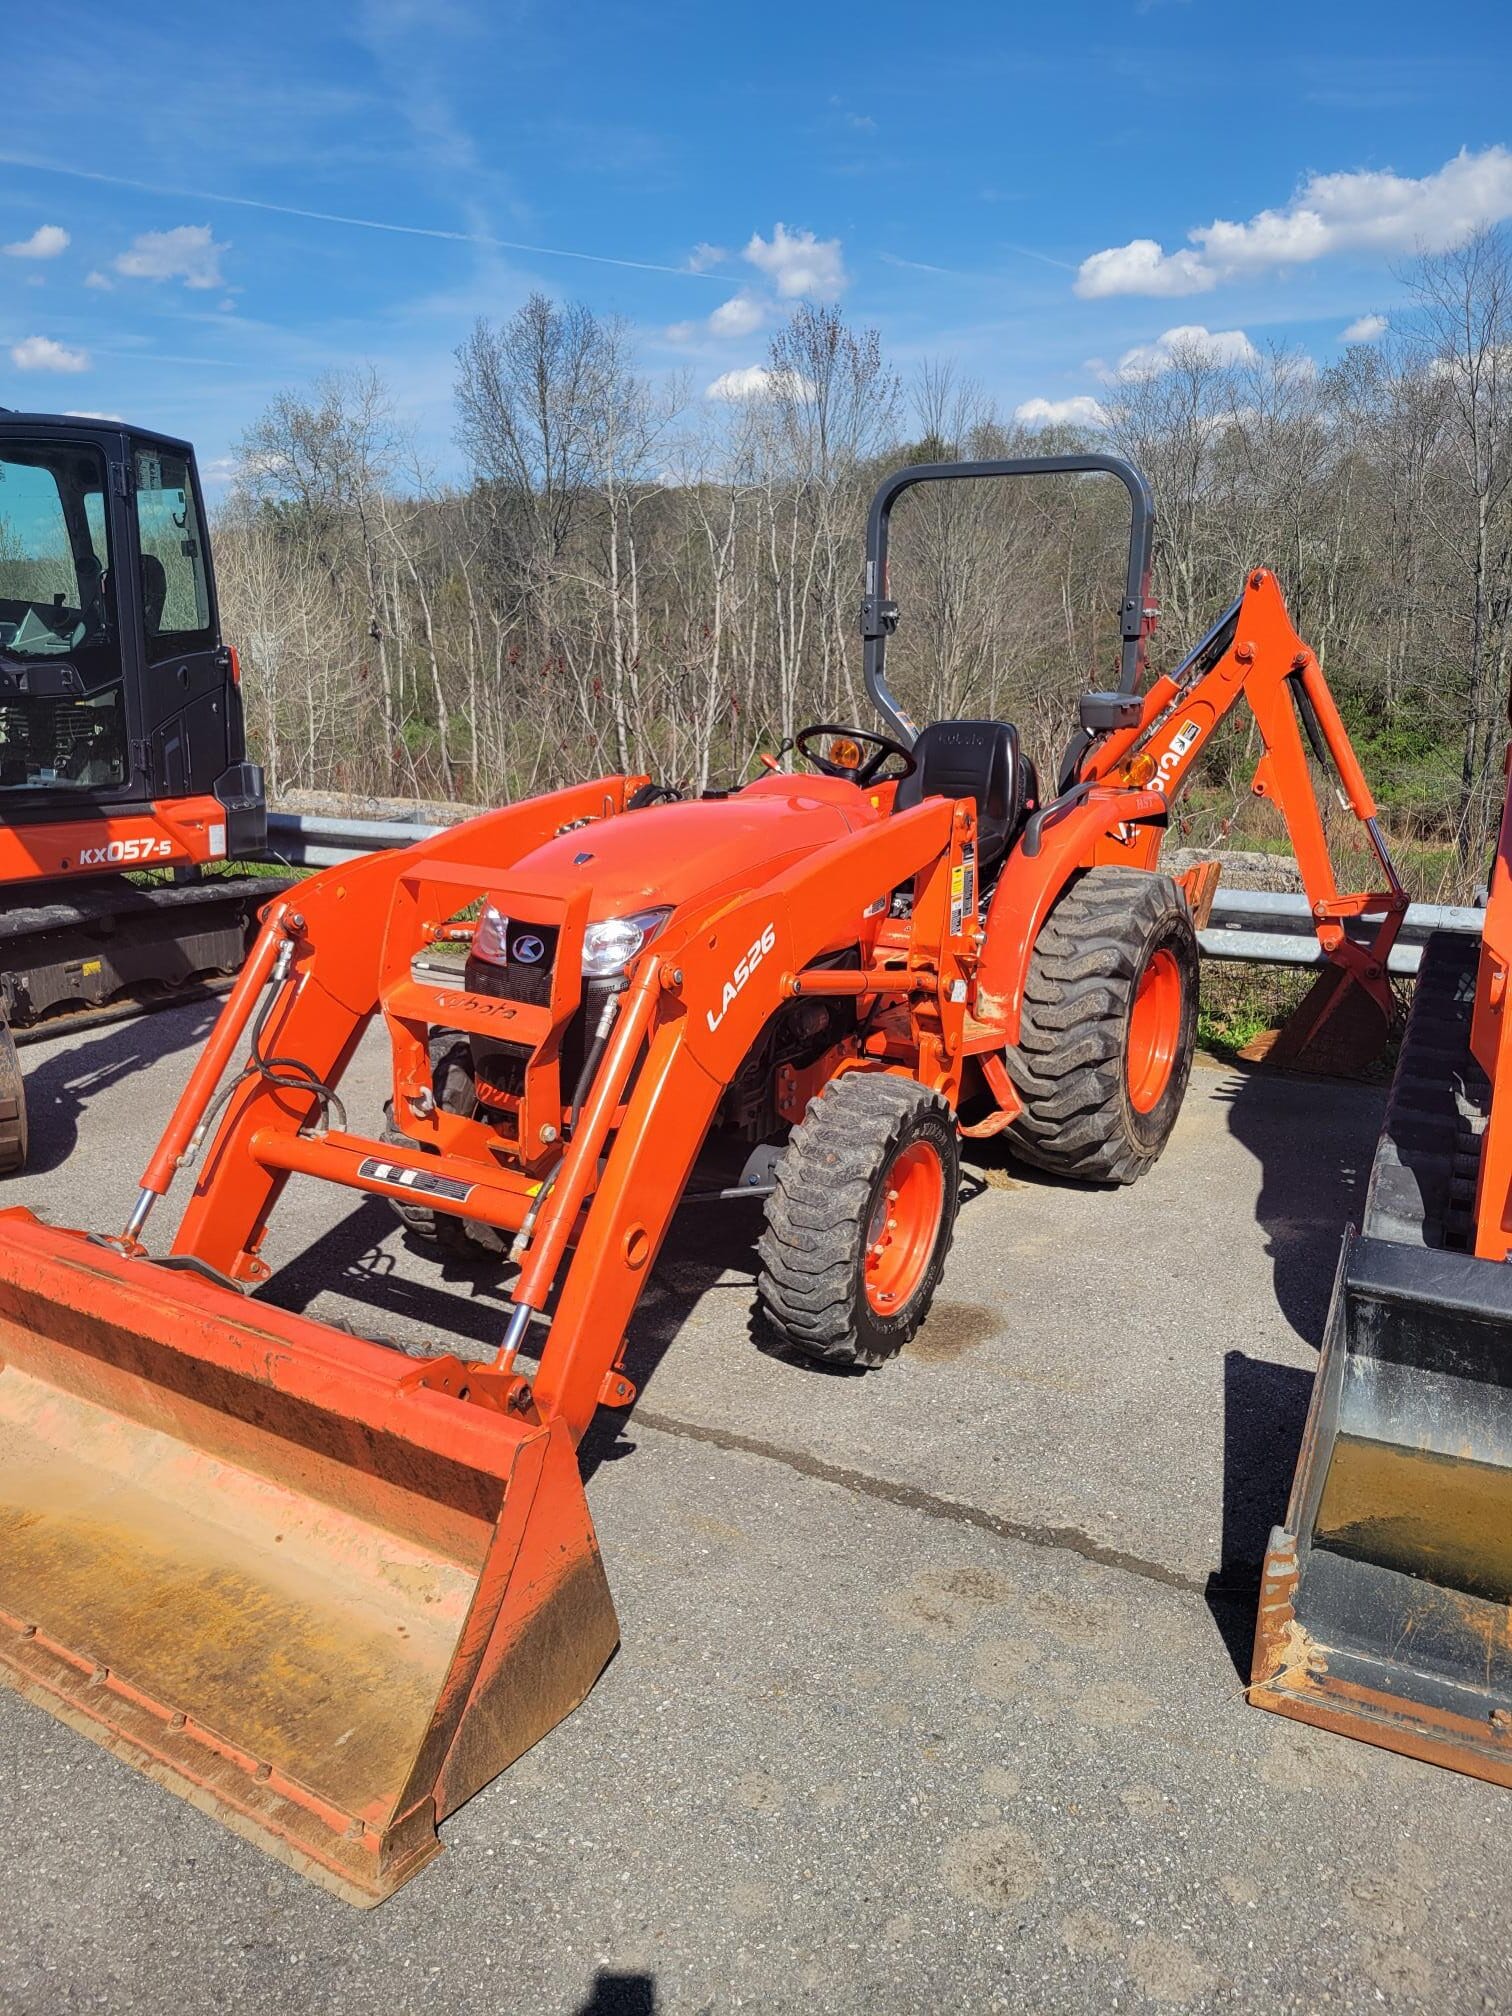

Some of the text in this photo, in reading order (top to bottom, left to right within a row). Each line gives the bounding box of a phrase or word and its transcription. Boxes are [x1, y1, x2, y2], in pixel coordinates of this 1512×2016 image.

[80, 838, 172, 865] KX057-5
[706, 922, 776, 1033] LA526
[434, 990, 518, 1020] Kubota
